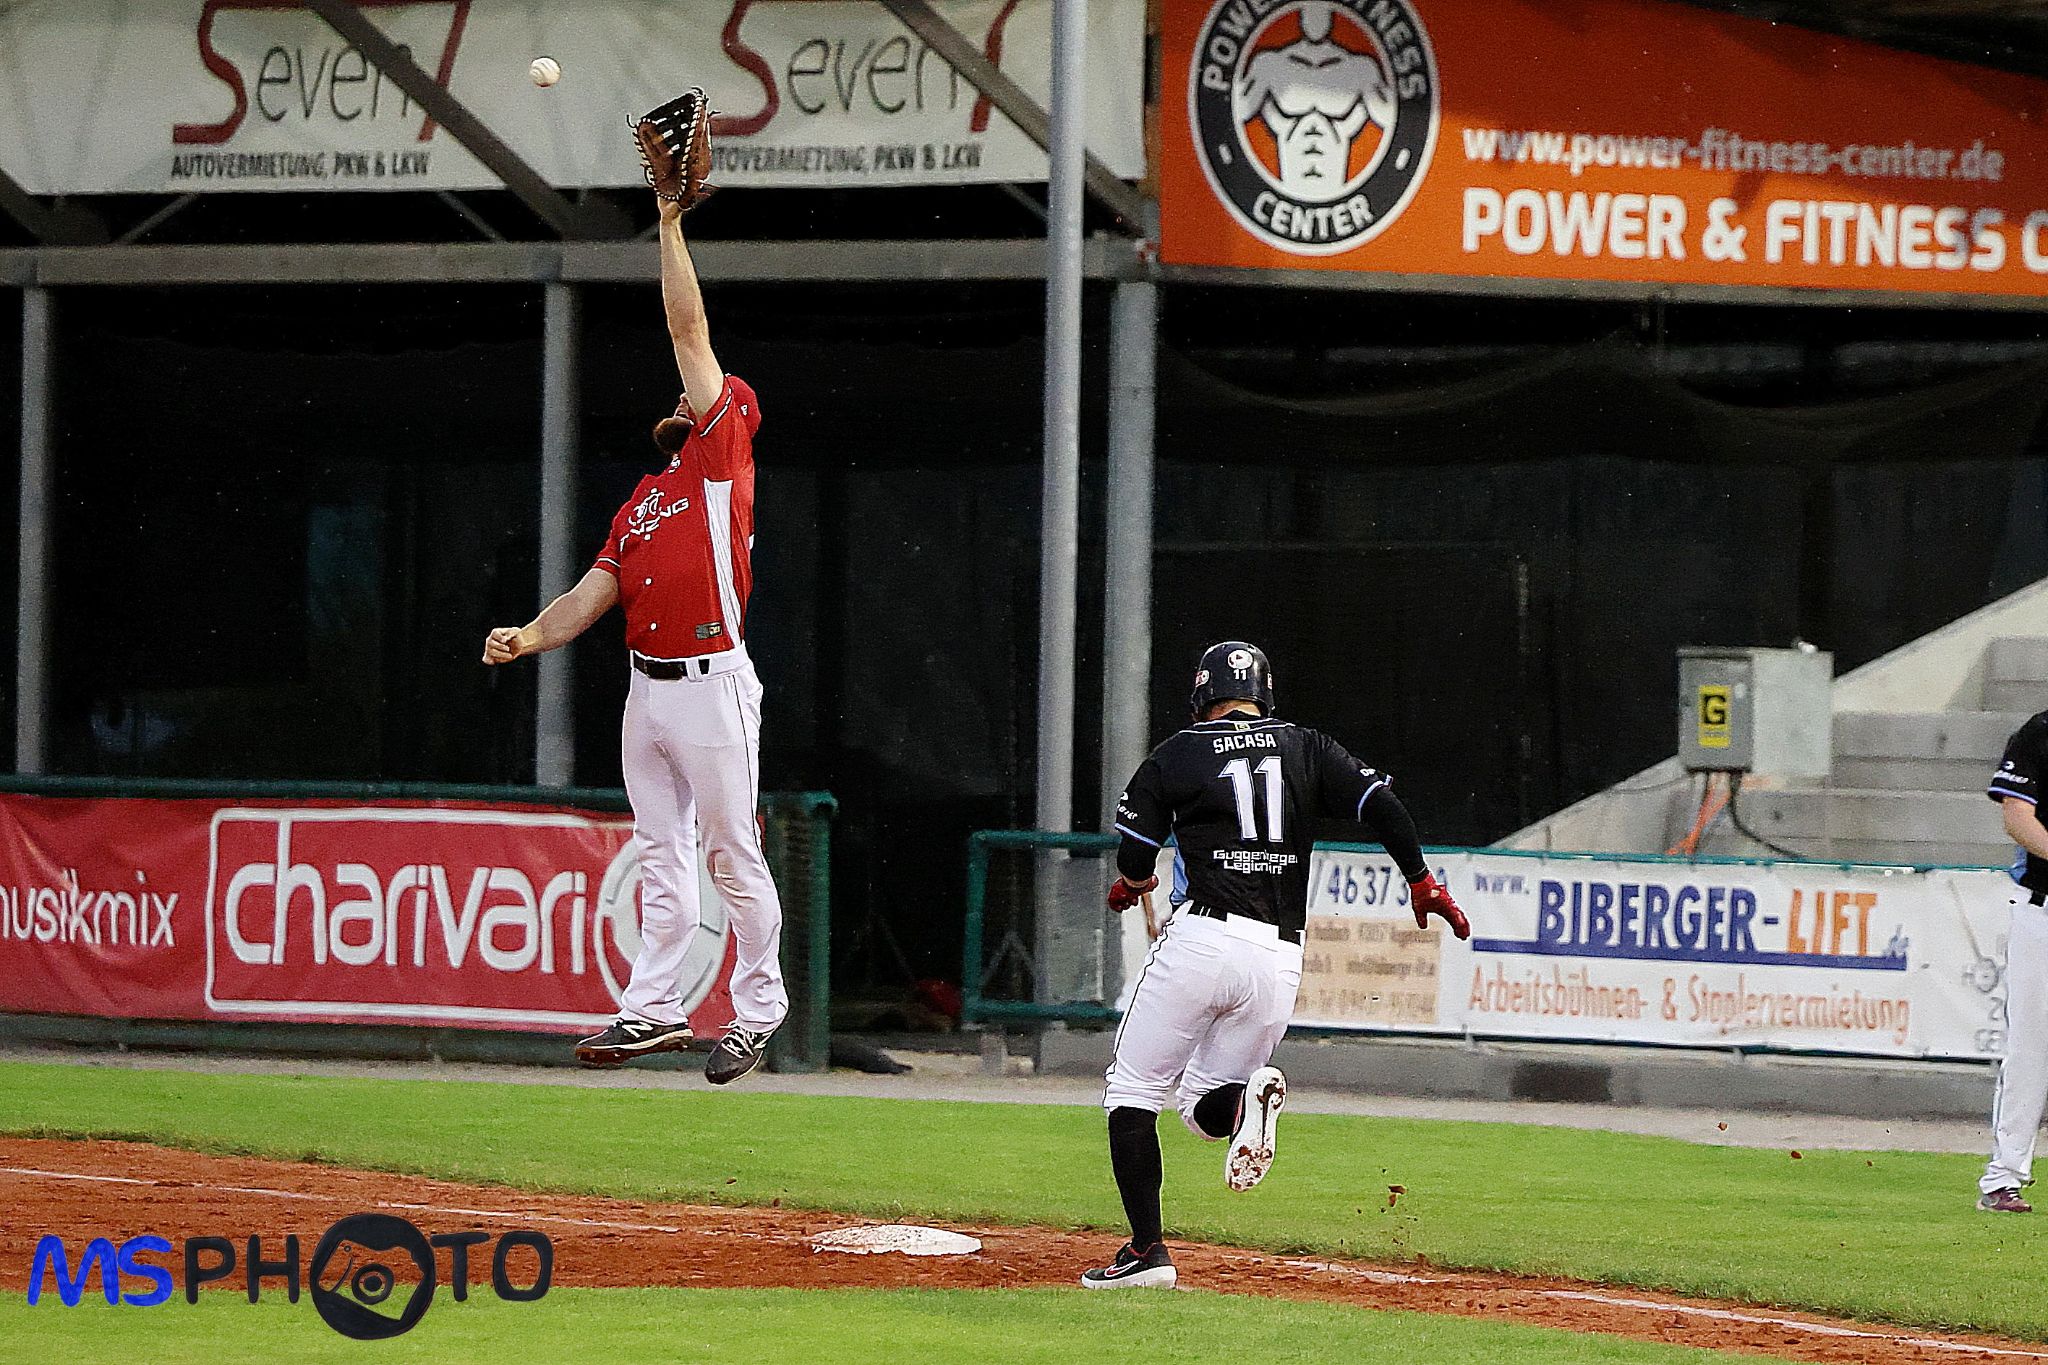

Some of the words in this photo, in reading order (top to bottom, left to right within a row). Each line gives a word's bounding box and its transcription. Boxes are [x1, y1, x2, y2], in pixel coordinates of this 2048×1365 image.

[1462, 127, 2005, 182] www.power-fitness-center.de
[1252, 190, 1374, 240] CENTER
[1462, 187, 1687, 262] POWER
[1702, 198, 1747, 263] &
[1765, 199, 2007, 272] FITNESS
[1233, 669, 1247, 680] 11
[1703, 694, 1726, 725] G
[1212, 732, 1277, 754] SACASA
[1217, 755, 1285, 842] 11
[0, 868, 179, 948] usikmix
[225, 819, 587, 975] charivari
[1662, 977, 1678, 1021] &
